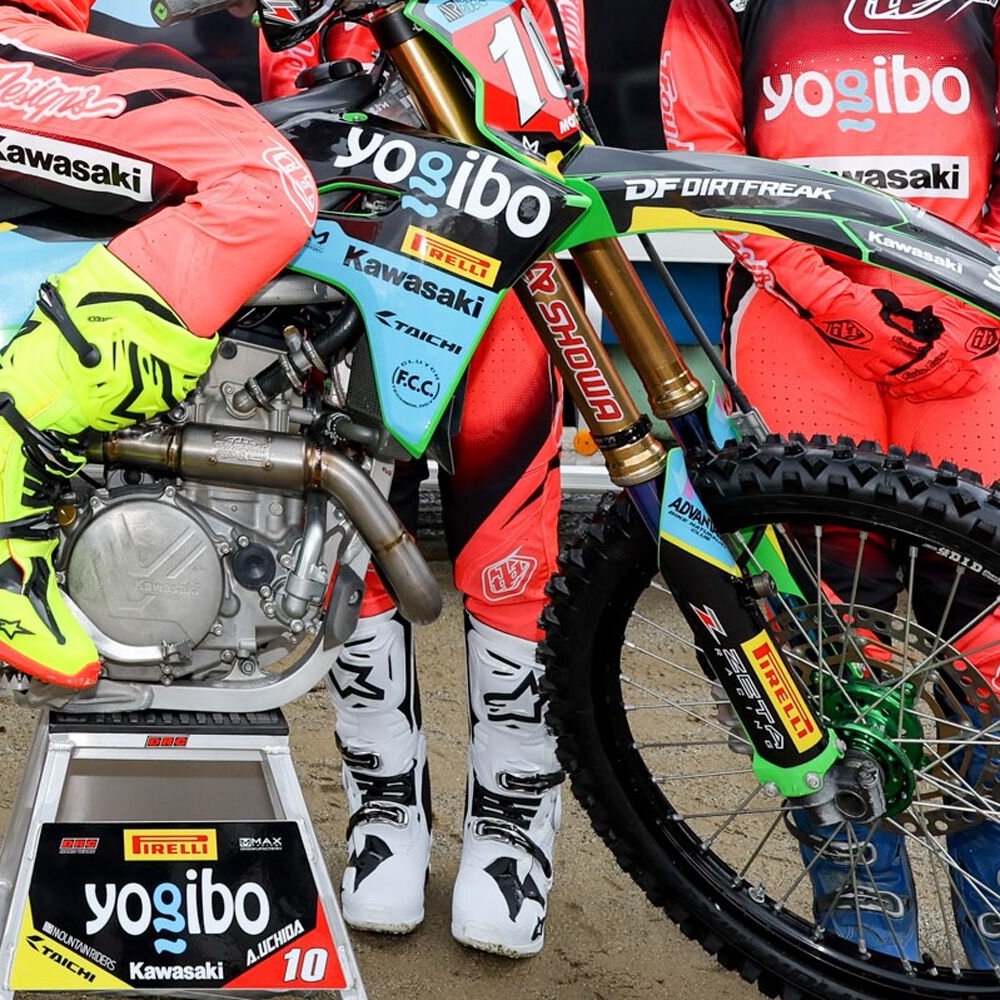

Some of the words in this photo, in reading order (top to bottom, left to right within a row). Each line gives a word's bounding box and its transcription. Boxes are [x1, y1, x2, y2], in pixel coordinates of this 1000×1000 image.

[763, 55, 970, 131] yogibo
[334, 127, 551, 238] yogibo
[624, 177, 682, 200] DF
[681, 178, 836, 200] DIRTFREAK
[410, 233, 491, 279] PIRELLI
[868, 230, 964, 274] Kawasaki
[343, 245, 485, 319] Kawasaki
[395, 320, 463, 356] TAICHI
[536, 299, 624, 423] SHOWA
[714, 647, 773, 750] RACING
[722, 647, 785, 750] ZETA
[751, 641, 814, 740] PIRELLI
[132, 834, 209, 855] PIRELLI
[250, 837, 283, 847] MAX
[85, 868, 271, 956] yogibo
[42, 945, 97, 983] TAICHI
[246, 919, 305, 967] A.UCHIDA
[283, 947, 329, 983] 10
[130, 961, 225, 981] Kawasaki
